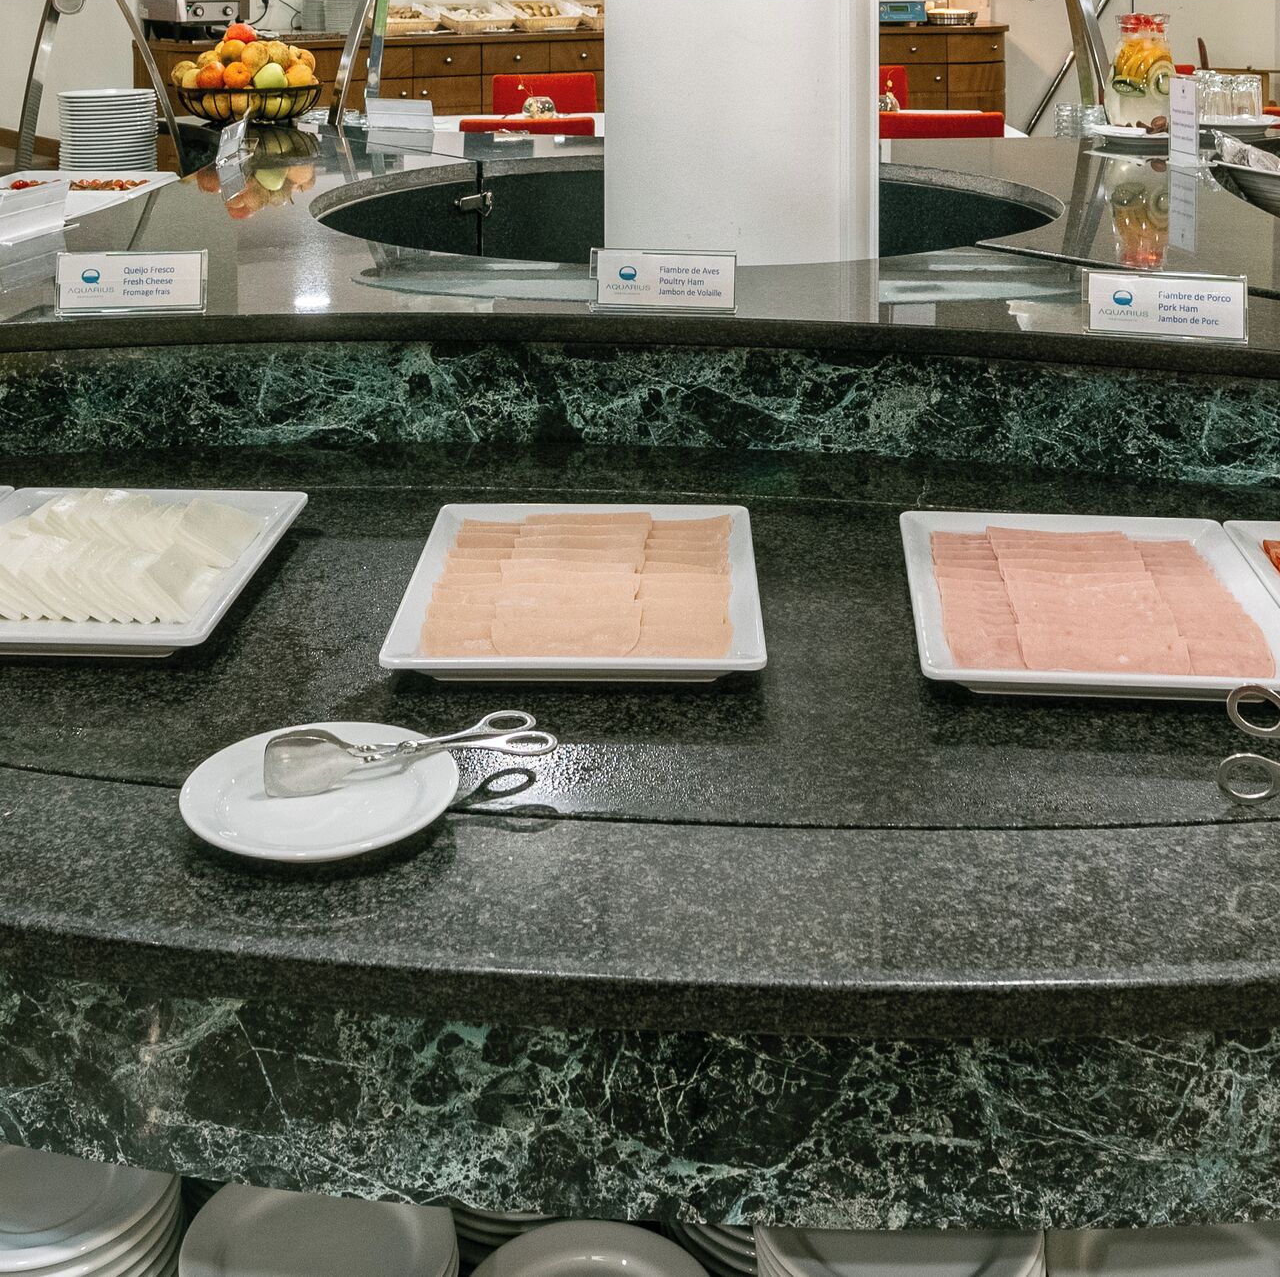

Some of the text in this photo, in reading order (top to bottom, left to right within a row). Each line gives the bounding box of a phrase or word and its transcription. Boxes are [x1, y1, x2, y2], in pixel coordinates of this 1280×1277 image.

[123, 266, 175, 275] Queijo Fresco
[660, 266, 720, 275] Fiambre de Aves
[145, 277, 173, 285] Cheese
[659, 277, 705, 287] Poultry Ham
[67, 286, 115, 294] AQUARIUS
[605, 283, 651, 291] AQUARIUS
[122, 287, 171, 297] Fromage frais
[659, 288, 722, 297] Jambon de Volaille
[1158, 291, 1231, 303] Fiambre de Porco
[1158, 303, 1199, 313] Pork Ham
[1098, 308, 1149, 318] AQUARIUS
[1158, 315, 1219, 326] Jambon de Porc
